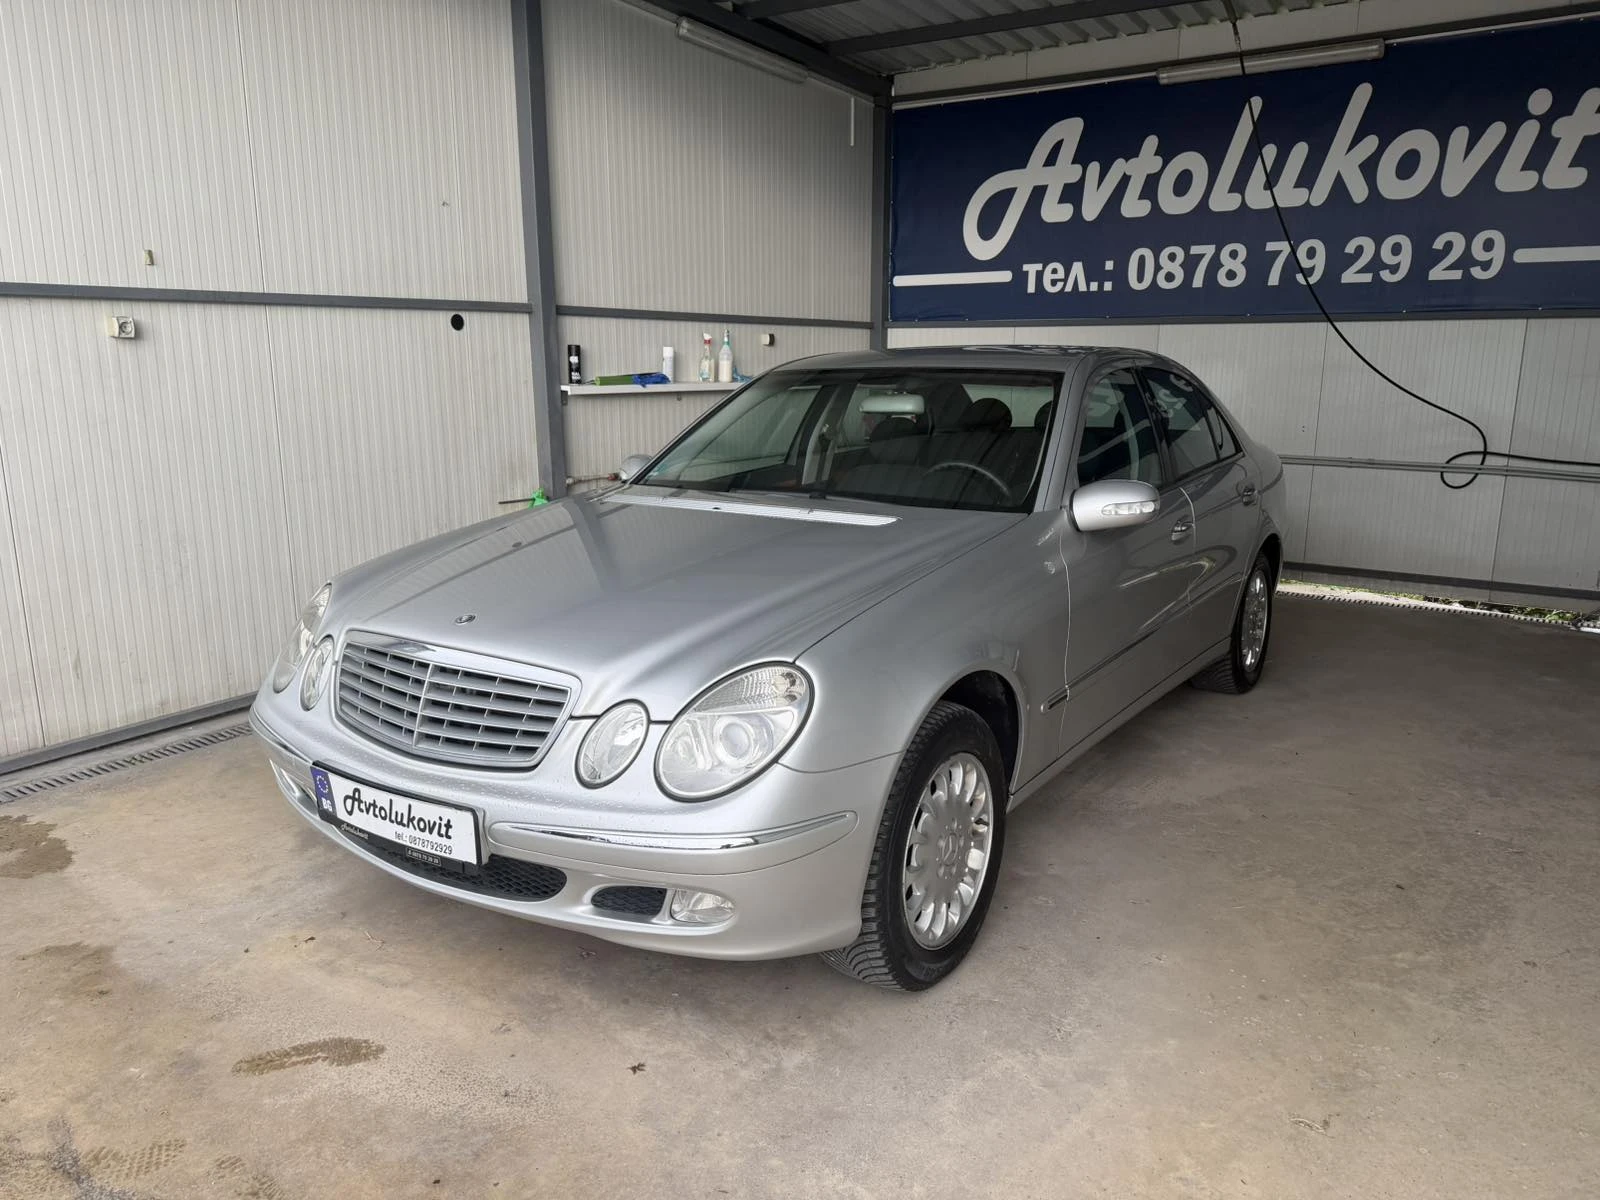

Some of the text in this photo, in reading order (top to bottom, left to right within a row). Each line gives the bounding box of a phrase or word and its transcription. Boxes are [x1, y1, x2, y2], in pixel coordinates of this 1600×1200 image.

[963, 83, 1600, 261] Avtolukovit
[1023, 230, 1506, 294] тел.: 0878 79 29 29
[321, 797, 333, 812] BG
[343, 786, 453, 840] Avtolukovit
[408, 835, 453, 855] 0878792929
